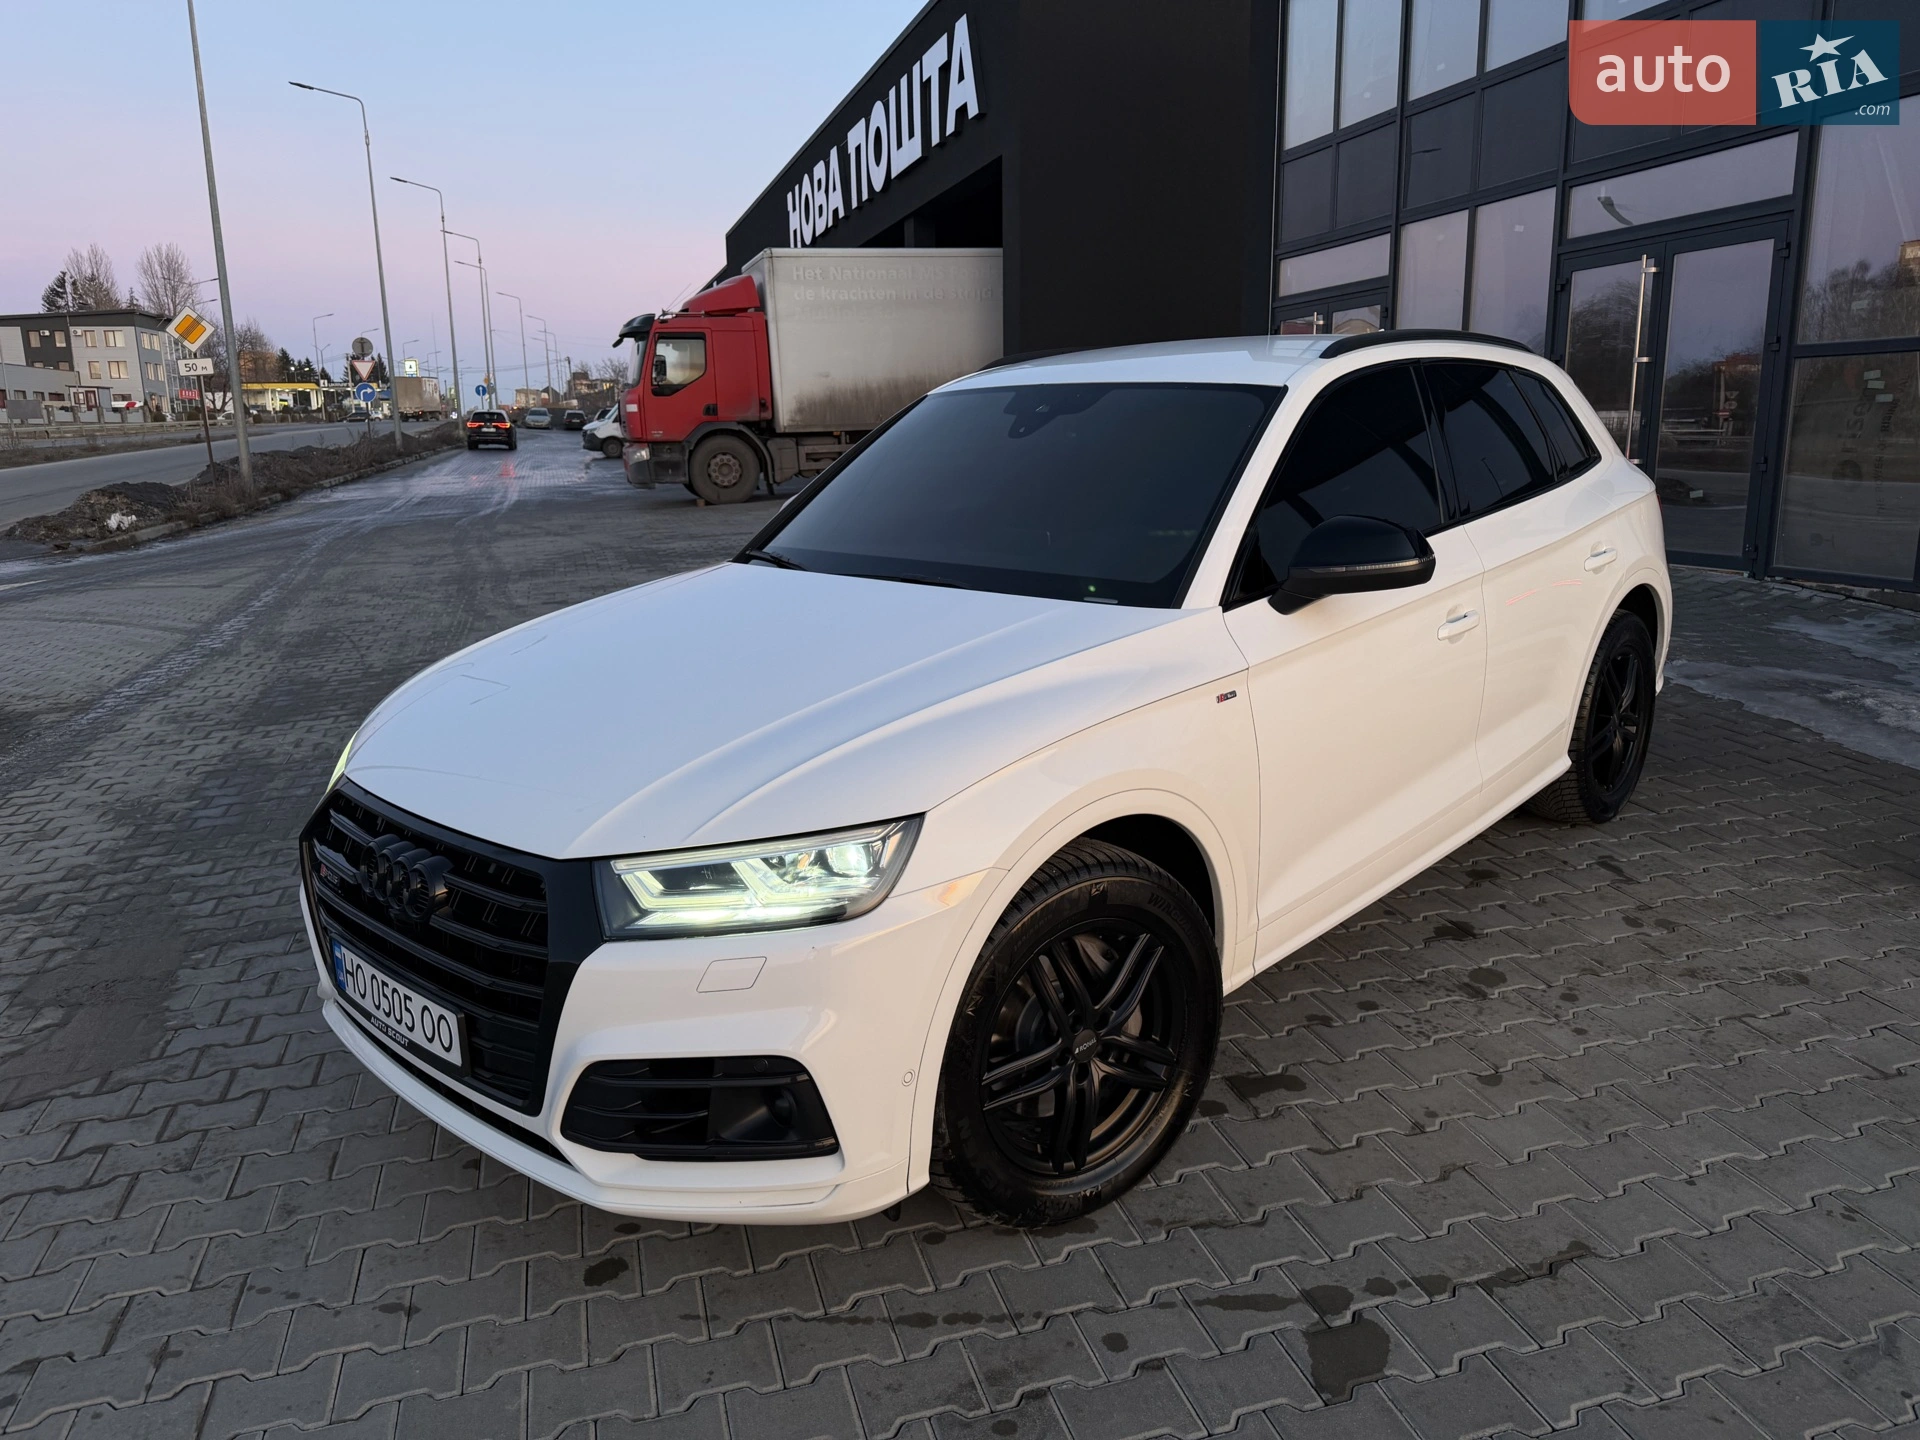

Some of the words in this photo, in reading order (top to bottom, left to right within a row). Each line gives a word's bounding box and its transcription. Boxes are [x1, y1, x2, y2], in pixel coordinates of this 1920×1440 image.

[786, 145, 845, 249] НОВА
[847, 13, 980, 210] ПОШТА
[792, 266, 823, 281] Het
[829, 266, 913, 281] Nationaal
[794, 286, 815, 301] de
[821, 286, 896, 301] krachten
[902, 286, 918, 301] in
[924, 286, 945, 301] de
[184, 363, 197, 372] 50
[343, 952, 367, 1000] HO
[370, 973, 416, 1033] 0505
[420, 1004, 454, 1053] OO
[370, 1016, 387, 1033] AUTO
[387, 1027, 410, 1047] SCOUT
